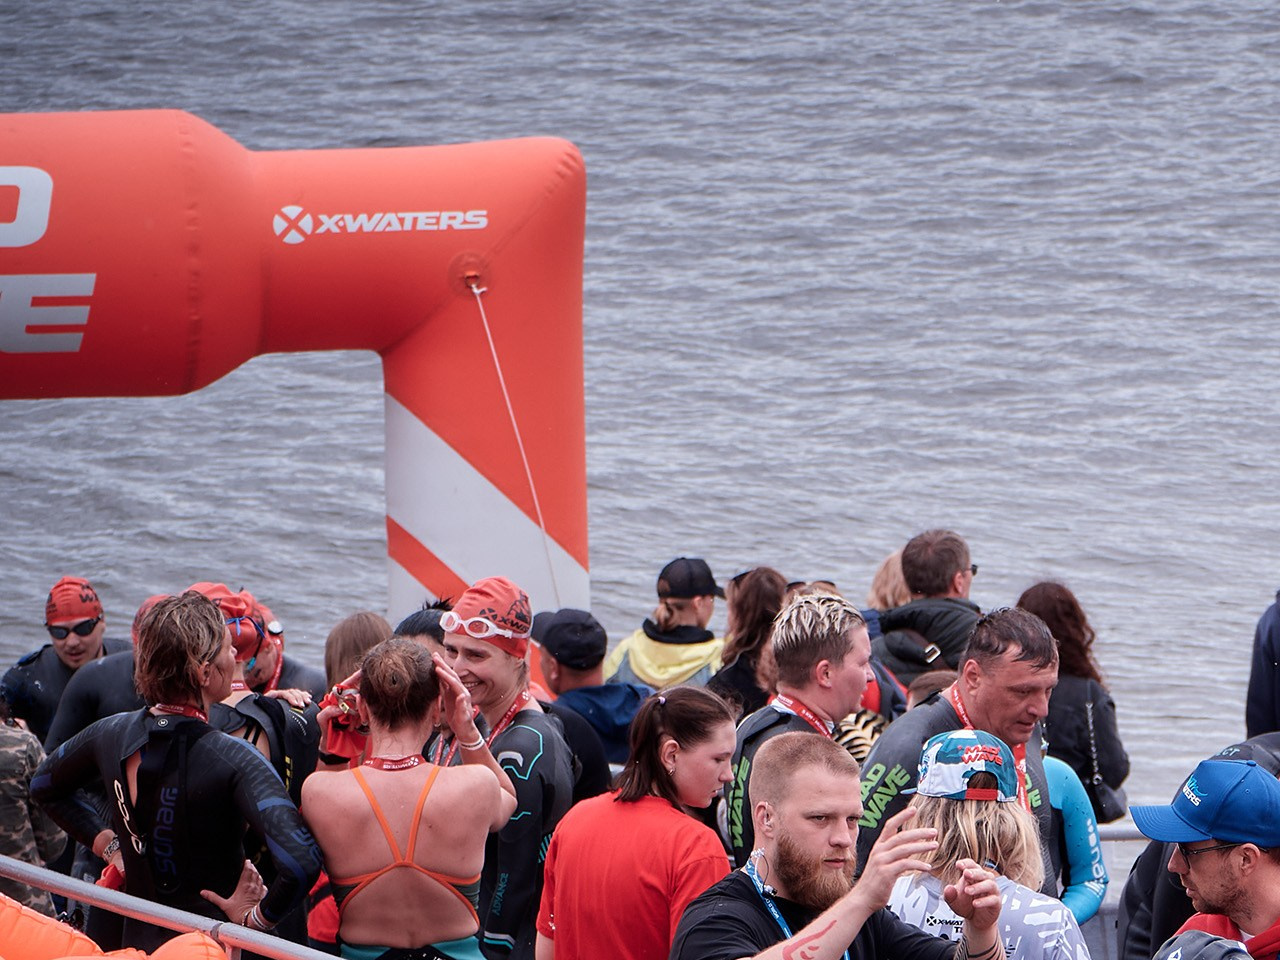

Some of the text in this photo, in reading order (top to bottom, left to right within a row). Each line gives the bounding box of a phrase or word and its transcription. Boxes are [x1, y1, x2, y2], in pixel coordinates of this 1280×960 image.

[961, 752, 1003, 766] WAVE
[964, 744, 1000, 756] MAD
[858, 763, 911, 829] WAVE
[861, 763, 886, 801] AD
[732, 756, 750, 848] WAVE
